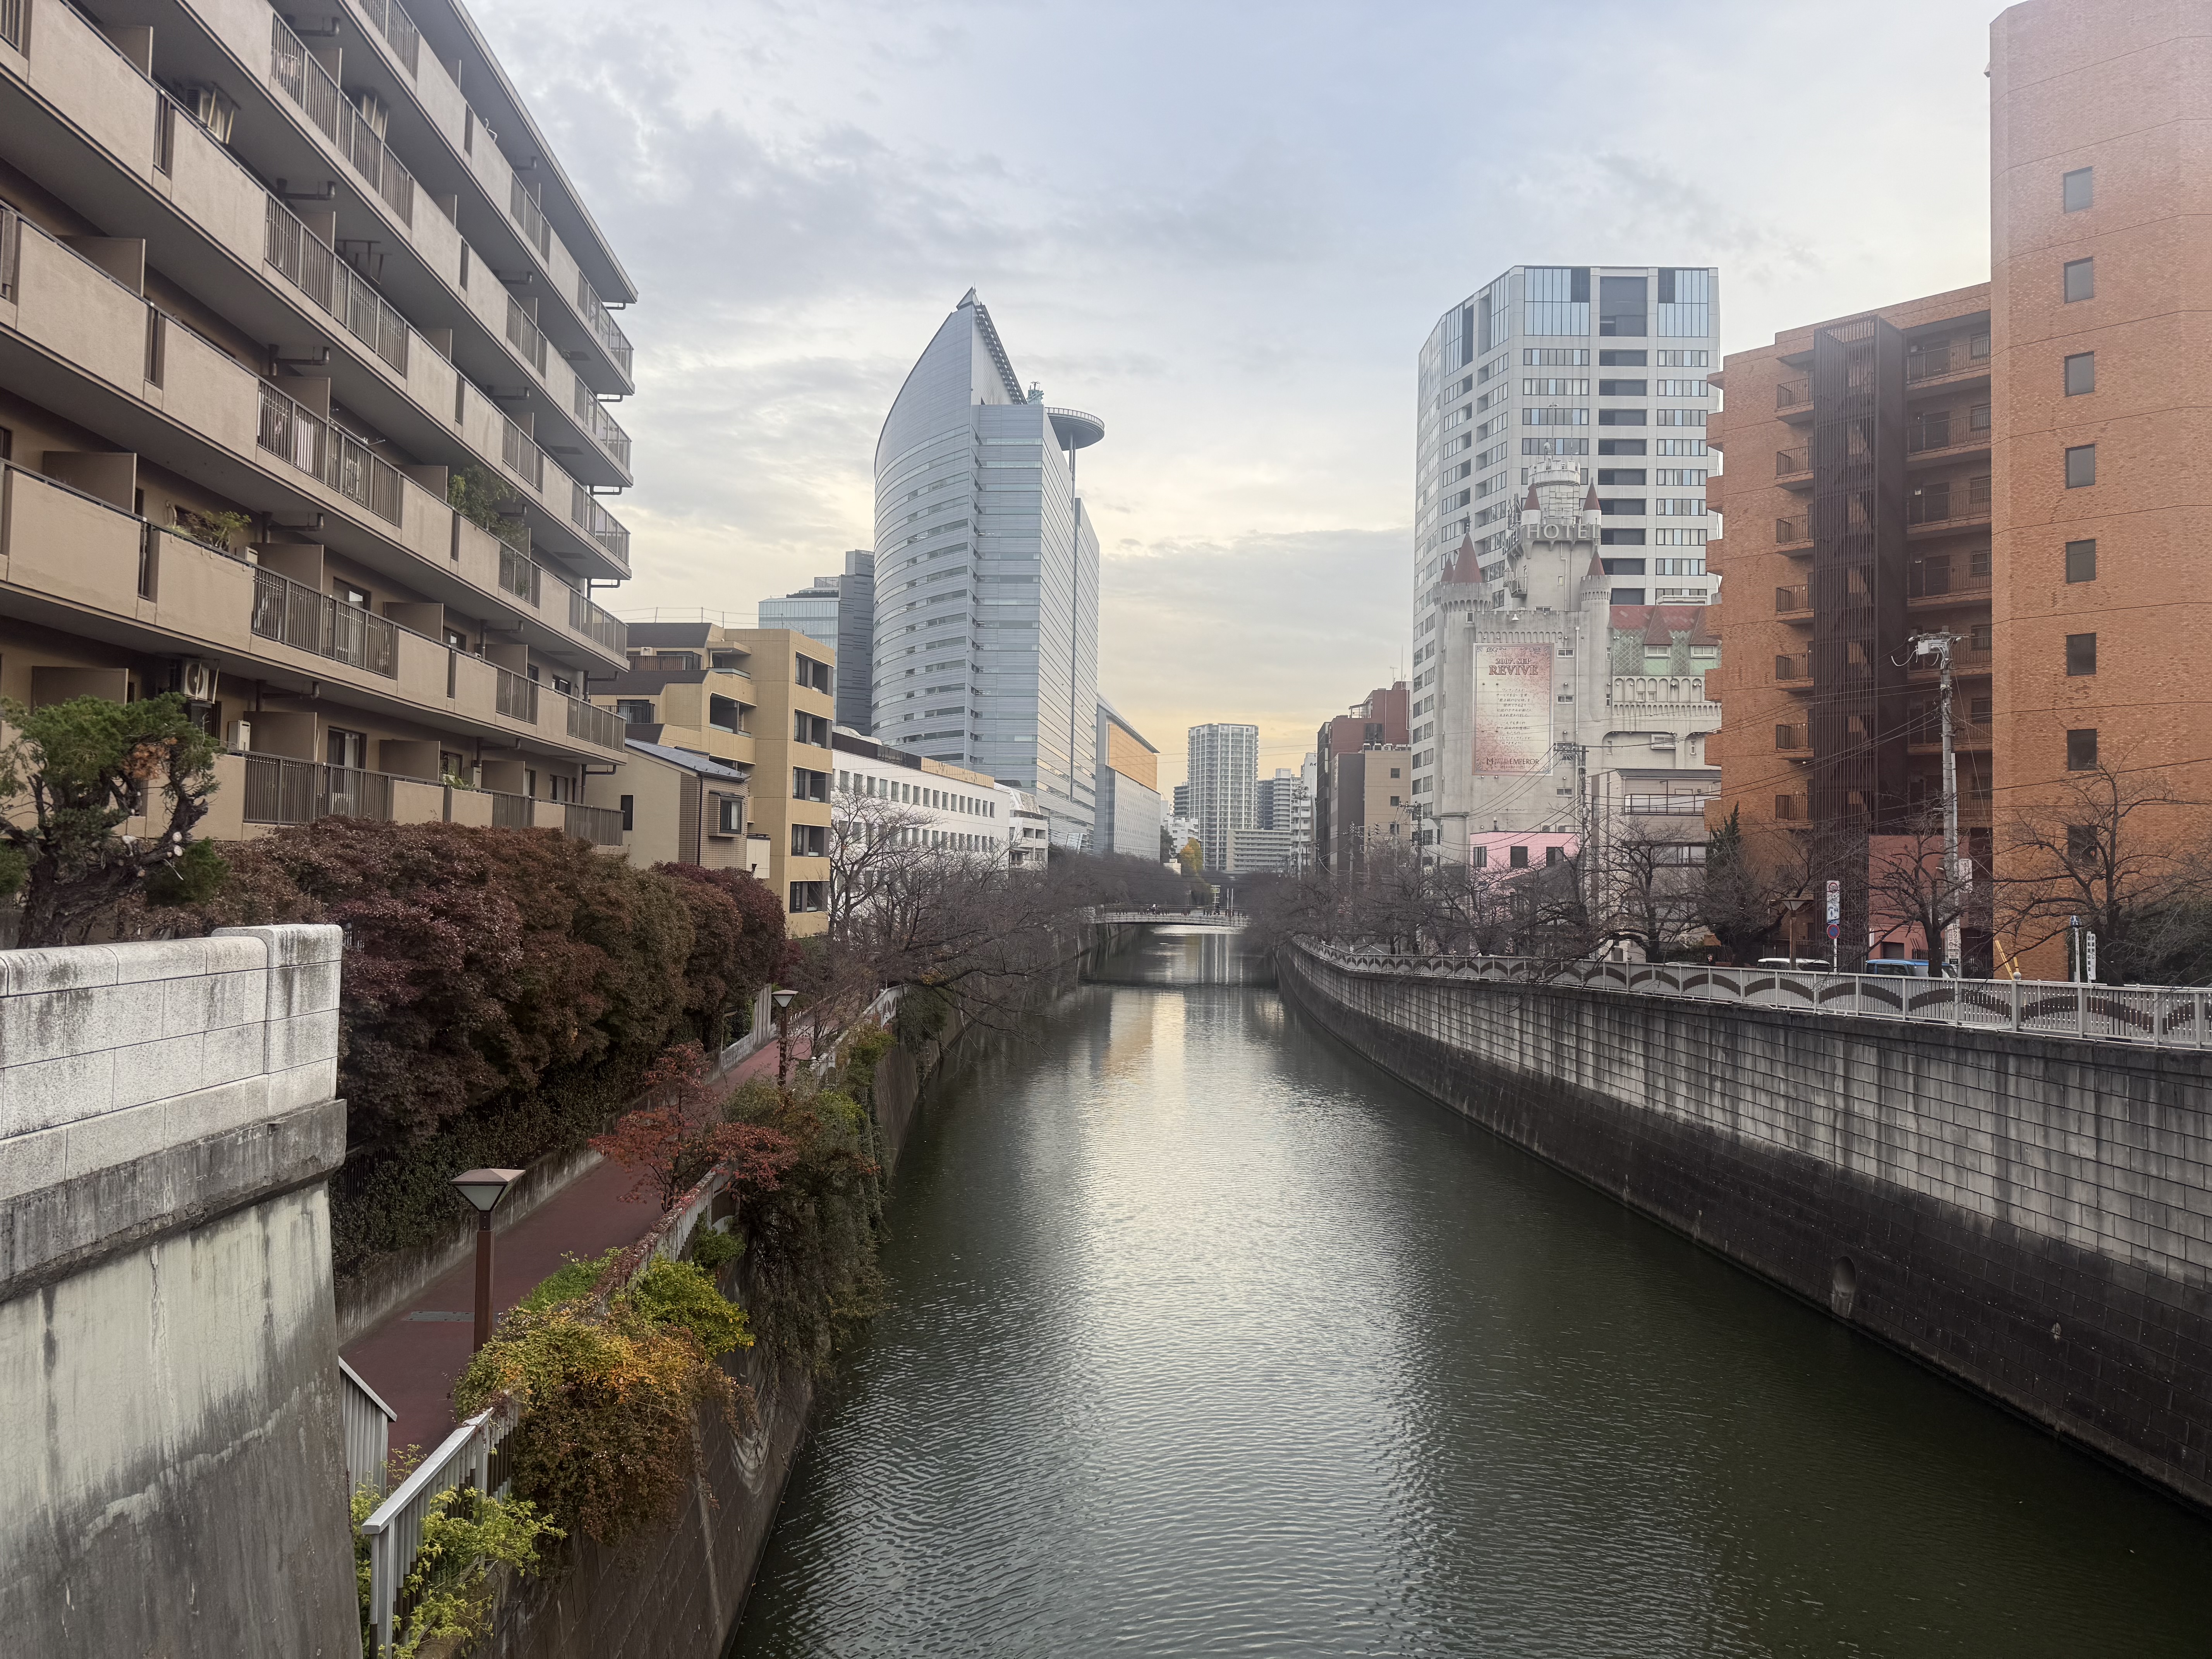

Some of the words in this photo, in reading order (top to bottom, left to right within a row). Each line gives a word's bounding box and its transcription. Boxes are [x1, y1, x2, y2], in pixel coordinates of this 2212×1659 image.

[1527, 524, 1601, 538] HOTEL
[1502, 527, 1518, 555] HOTEL
[1489, 665, 1538, 675] REVIVE
